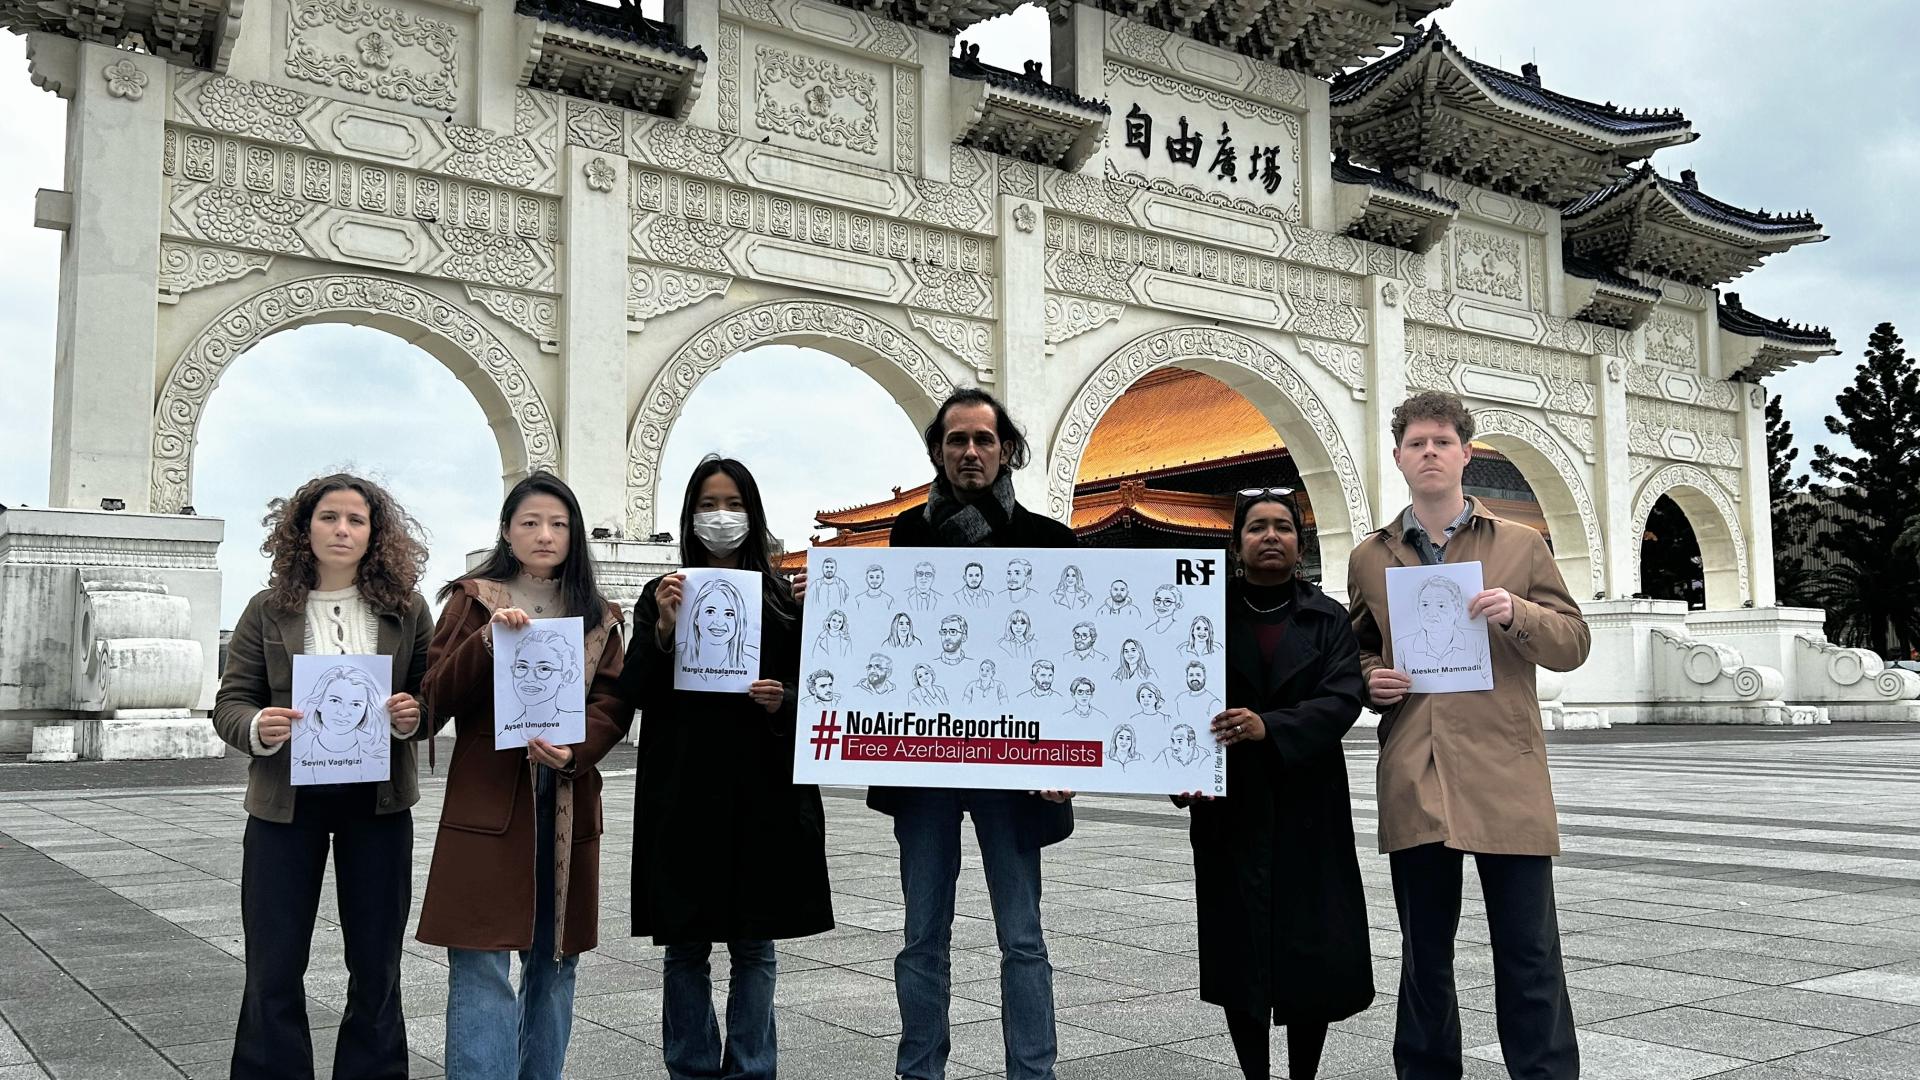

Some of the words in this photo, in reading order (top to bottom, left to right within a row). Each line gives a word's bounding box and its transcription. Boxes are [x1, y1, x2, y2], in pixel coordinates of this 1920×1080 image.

[1125, 103, 1282, 194] 自由廣場
[1176, 559, 1215, 585] RSF
[682, 666, 704, 675] Nargiz
[705, 667, 748, 675] Absalamova
[1441, 665, 1482, 673] Mammadli
[504, 722, 523, 731] Aysel
[525, 721, 560, 729] Umudova
[847, 738, 888, 757] Free
[893, 739, 992, 763] Azerbaijani
[997, 742, 1097, 763] Journalists
[328, 758, 362, 767] Vagifgizi
[1215, 774, 1223, 783] RSF
